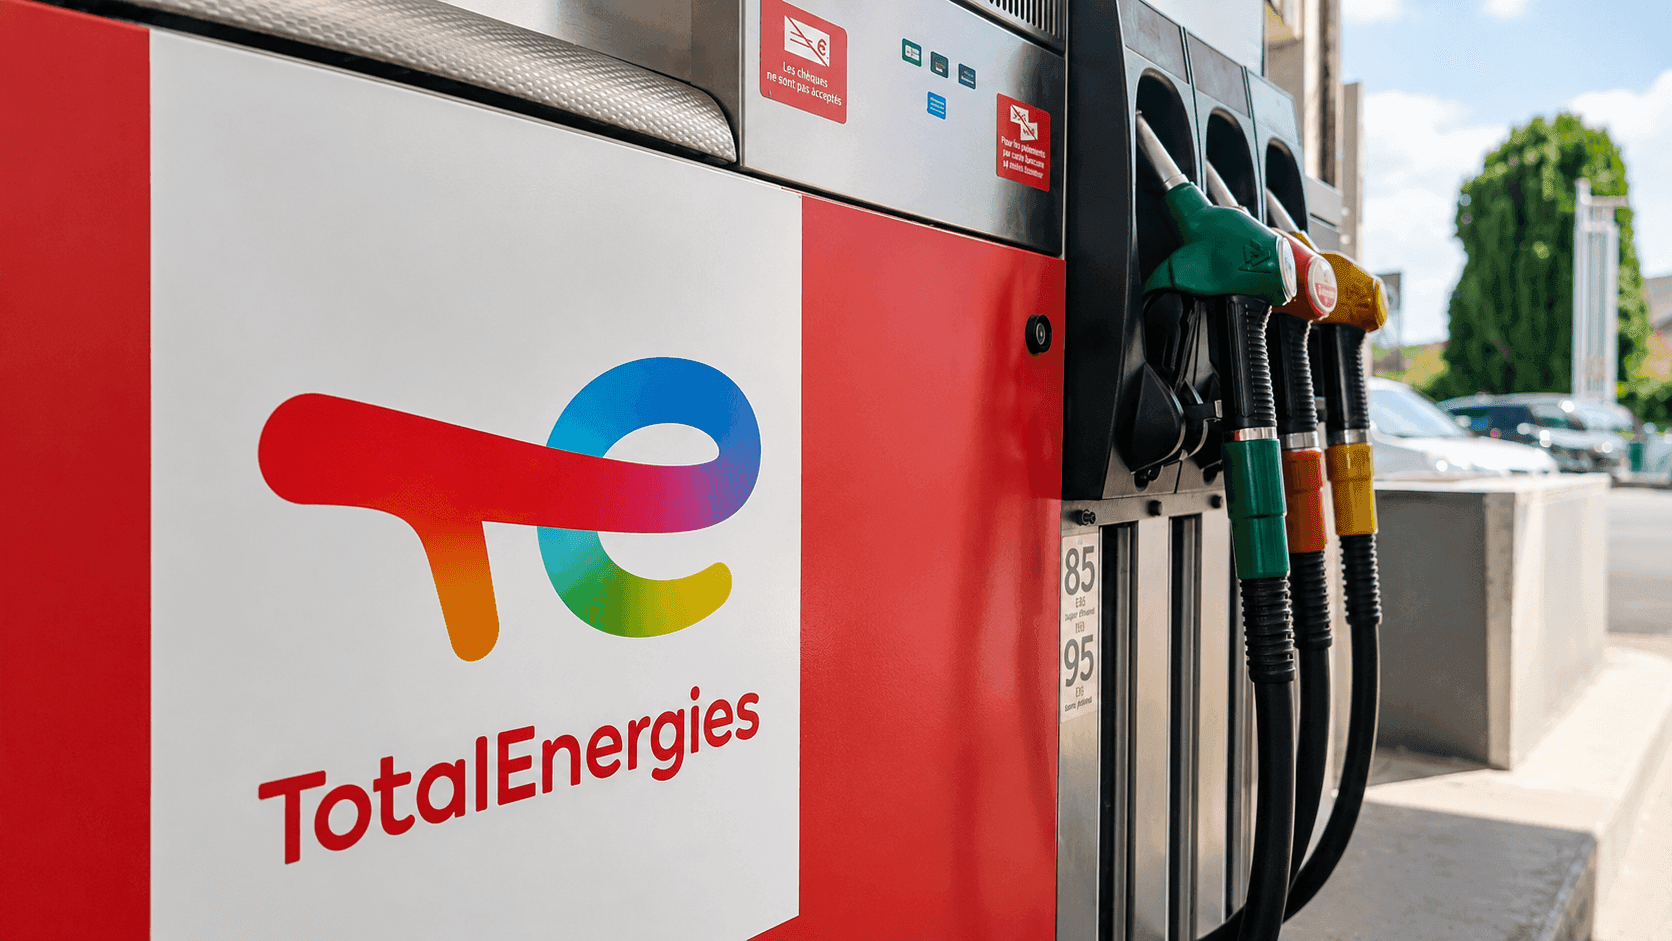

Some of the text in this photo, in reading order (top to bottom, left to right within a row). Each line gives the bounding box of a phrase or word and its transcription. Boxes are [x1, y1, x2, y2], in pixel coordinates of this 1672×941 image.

[766, 71, 777, 82] ne
[778, 75, 796, 90] sont
[797, 82, 810, 94] pas
[783, 61, 796, 76] Les
[1064, 545, 1095, 595] 85
[1064, 634, 1094, 687] 95
[258, 686, 760, 865] TotalEnergies
